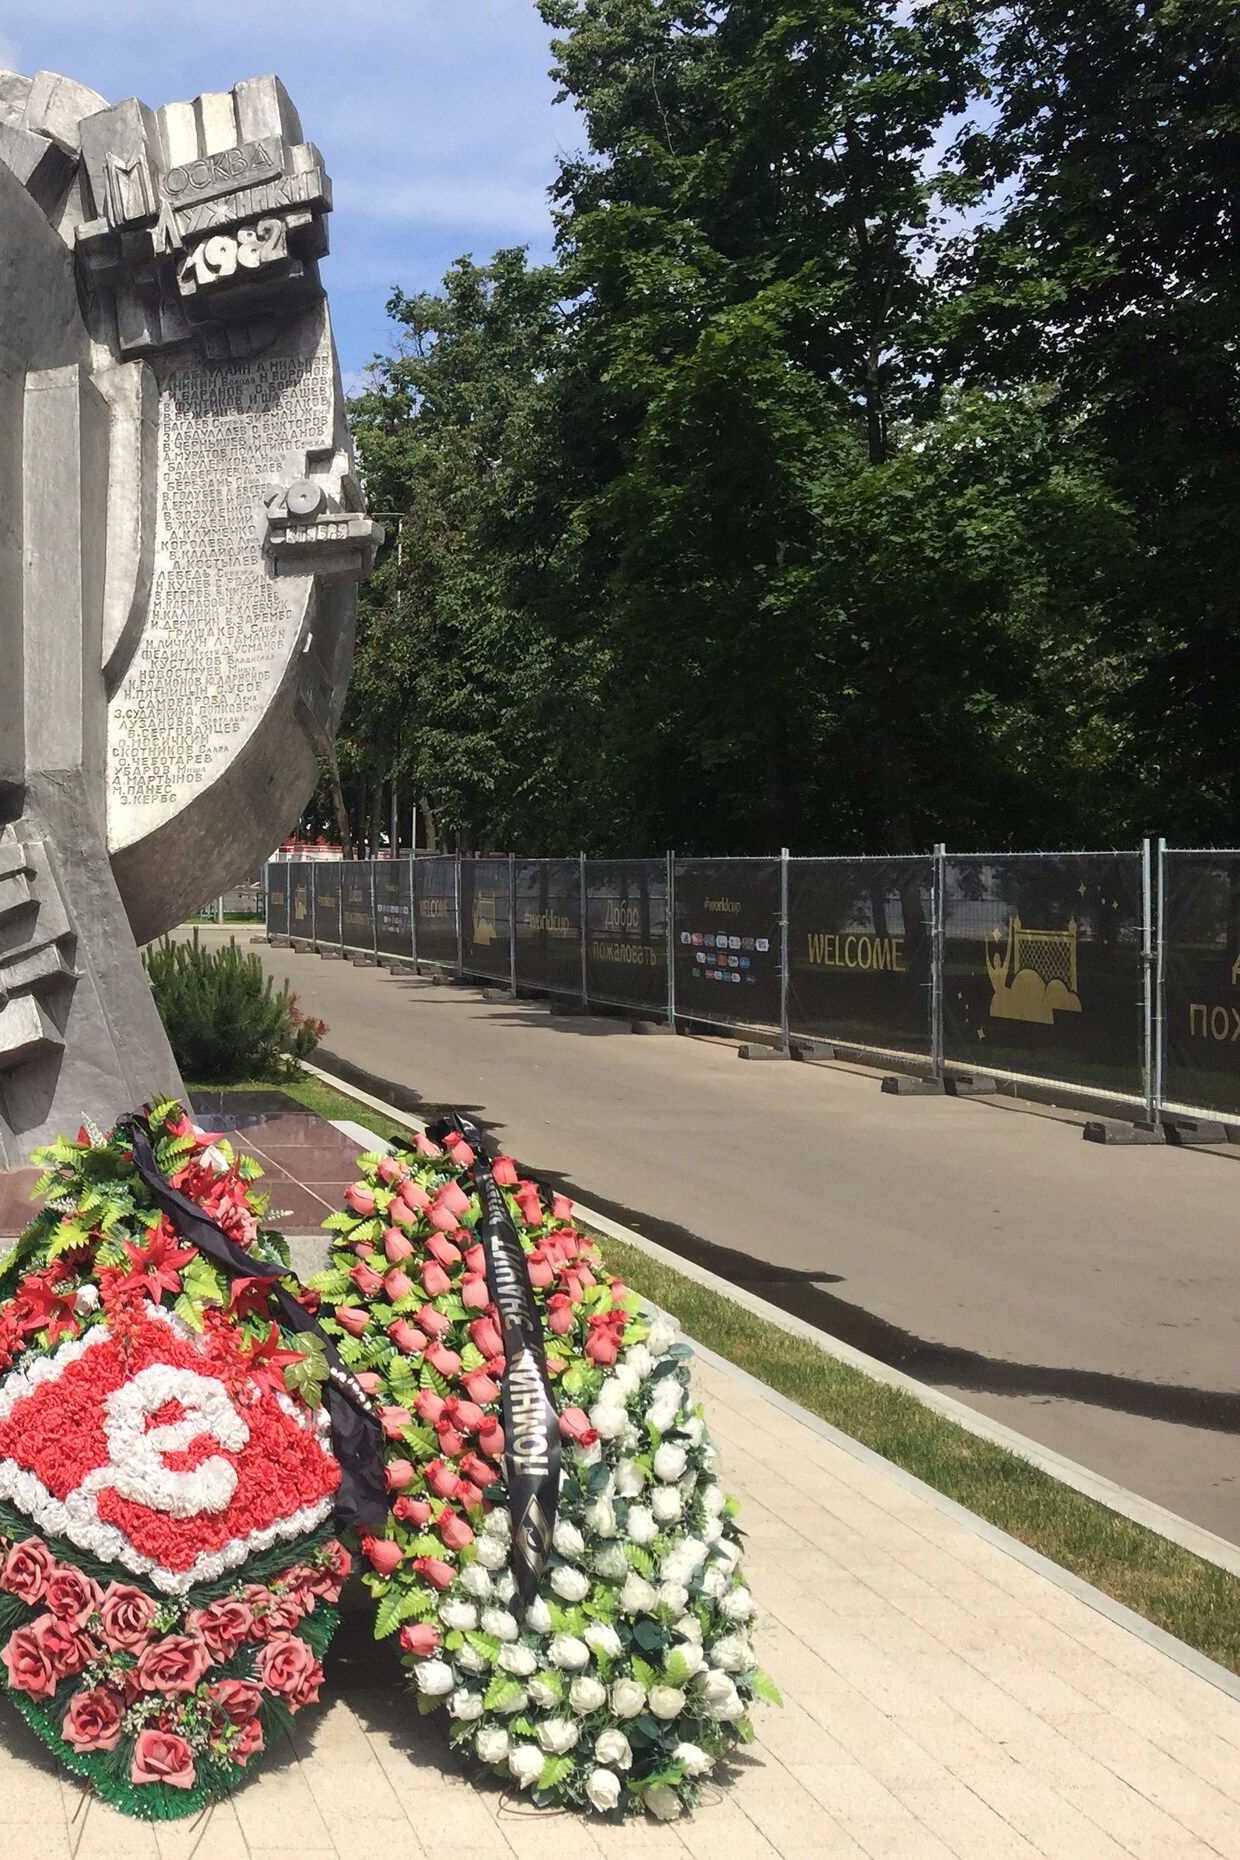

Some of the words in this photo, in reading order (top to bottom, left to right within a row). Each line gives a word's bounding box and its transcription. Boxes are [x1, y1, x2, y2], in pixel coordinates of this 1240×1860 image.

[103, 143, 275, 228] МОСКВА
[148, 167, 322, 256] ЛУЖНИКИ
[176, 218, 289, 296] 1982
[164, 420, 209, 433] БАГАЕВ
[161, 538, 233, 551] КОРОЛЕВА
[158, 569, 210, 581] ЛЕБЕДЬ
[168, 626, 244, 640] ГРИШАКОВ
[141, 649, 186, 660] ФЕДИН
[151, 656, 221, 670] КУСТИКОВ
[140, 666, 221, 680] НОВОСТРУЕВ
[119, 717, 194, 730] ЛУЗАНОВА
[112, 745, 193, 757] СКОТНИКОВ
[114, 766, 170, 776] УБАРОВ
[523, 907, 569, 938] #worldcup
[604, 900, 640, 933] Добро
[593, 941, 657, 966] пожаловать
[808, 933, 906, 971] WELCOME
[491, 1236, 532, 1331] ЗНАЧИТ
